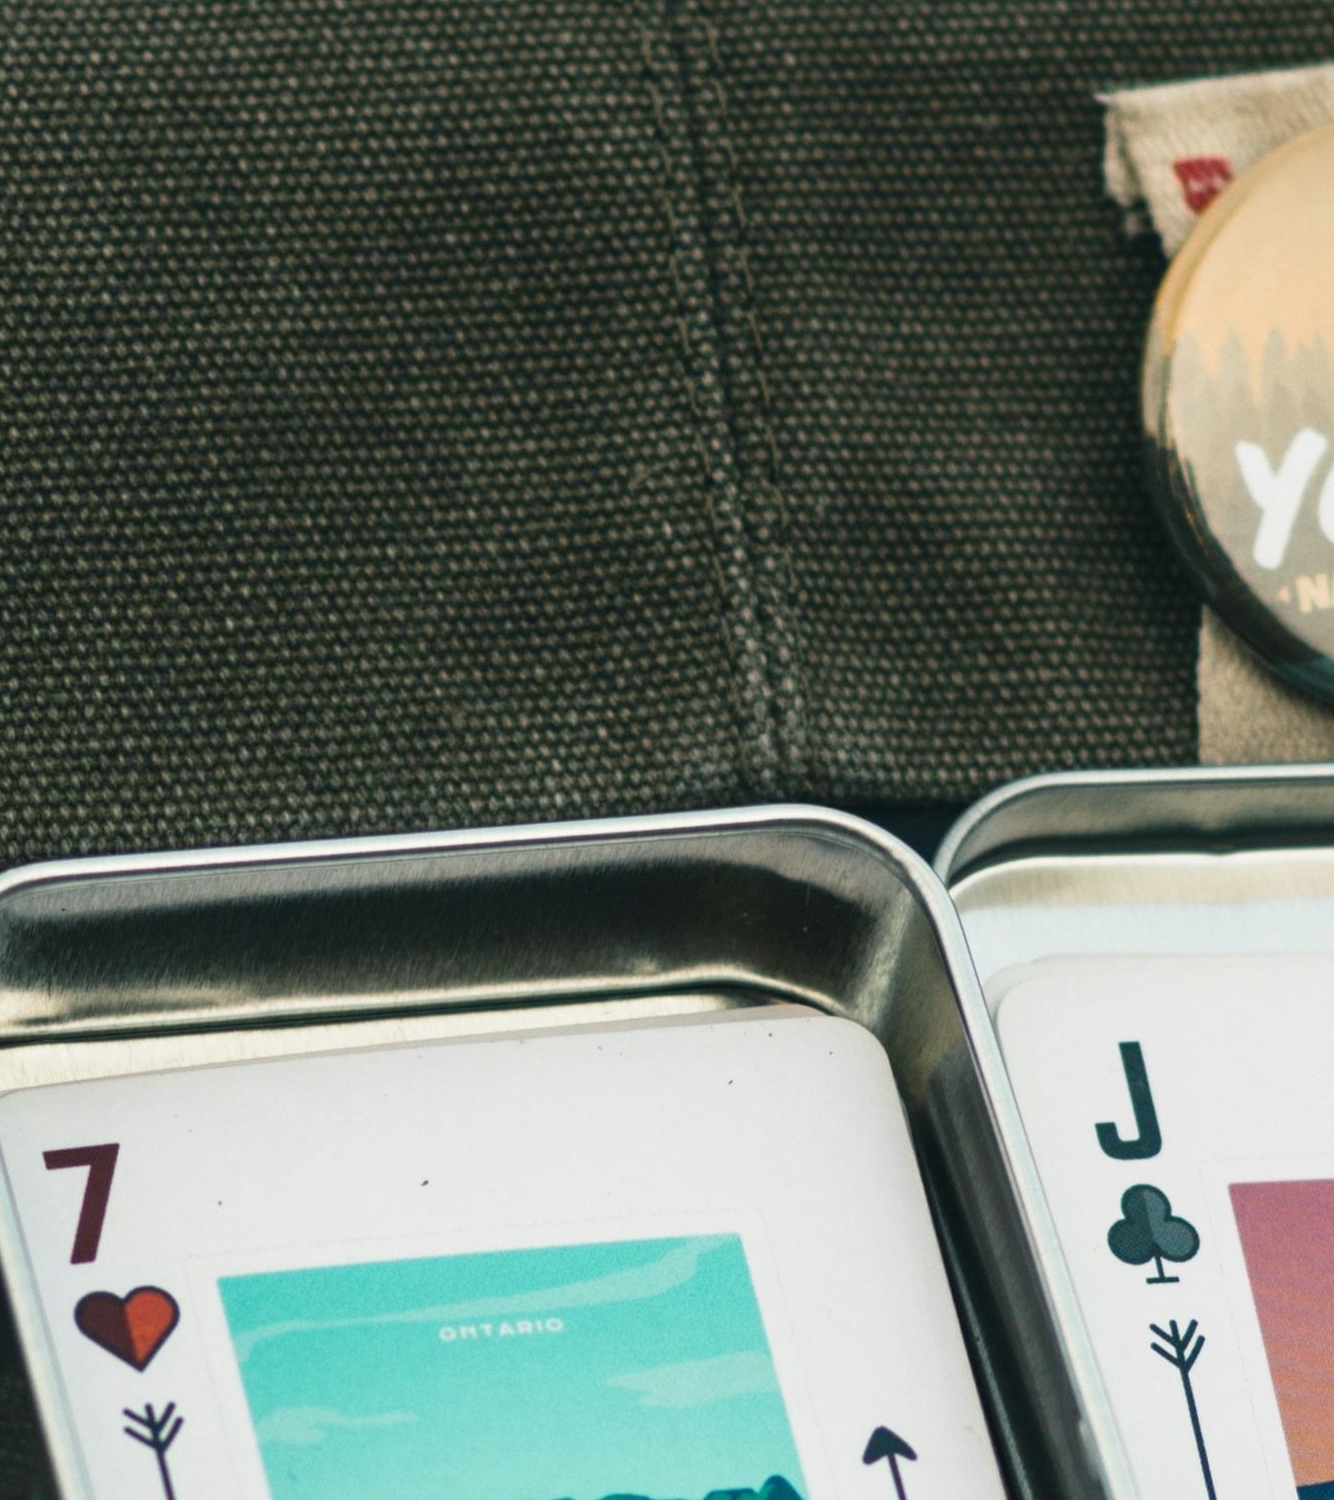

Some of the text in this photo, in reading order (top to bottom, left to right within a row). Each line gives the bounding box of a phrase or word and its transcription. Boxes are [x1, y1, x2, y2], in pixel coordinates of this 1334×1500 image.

[1094, 1041, 1162, 1160] J
[43, 1143, 120, 1264] 7
[438, 1318, 564, 1342] ONTARIO
